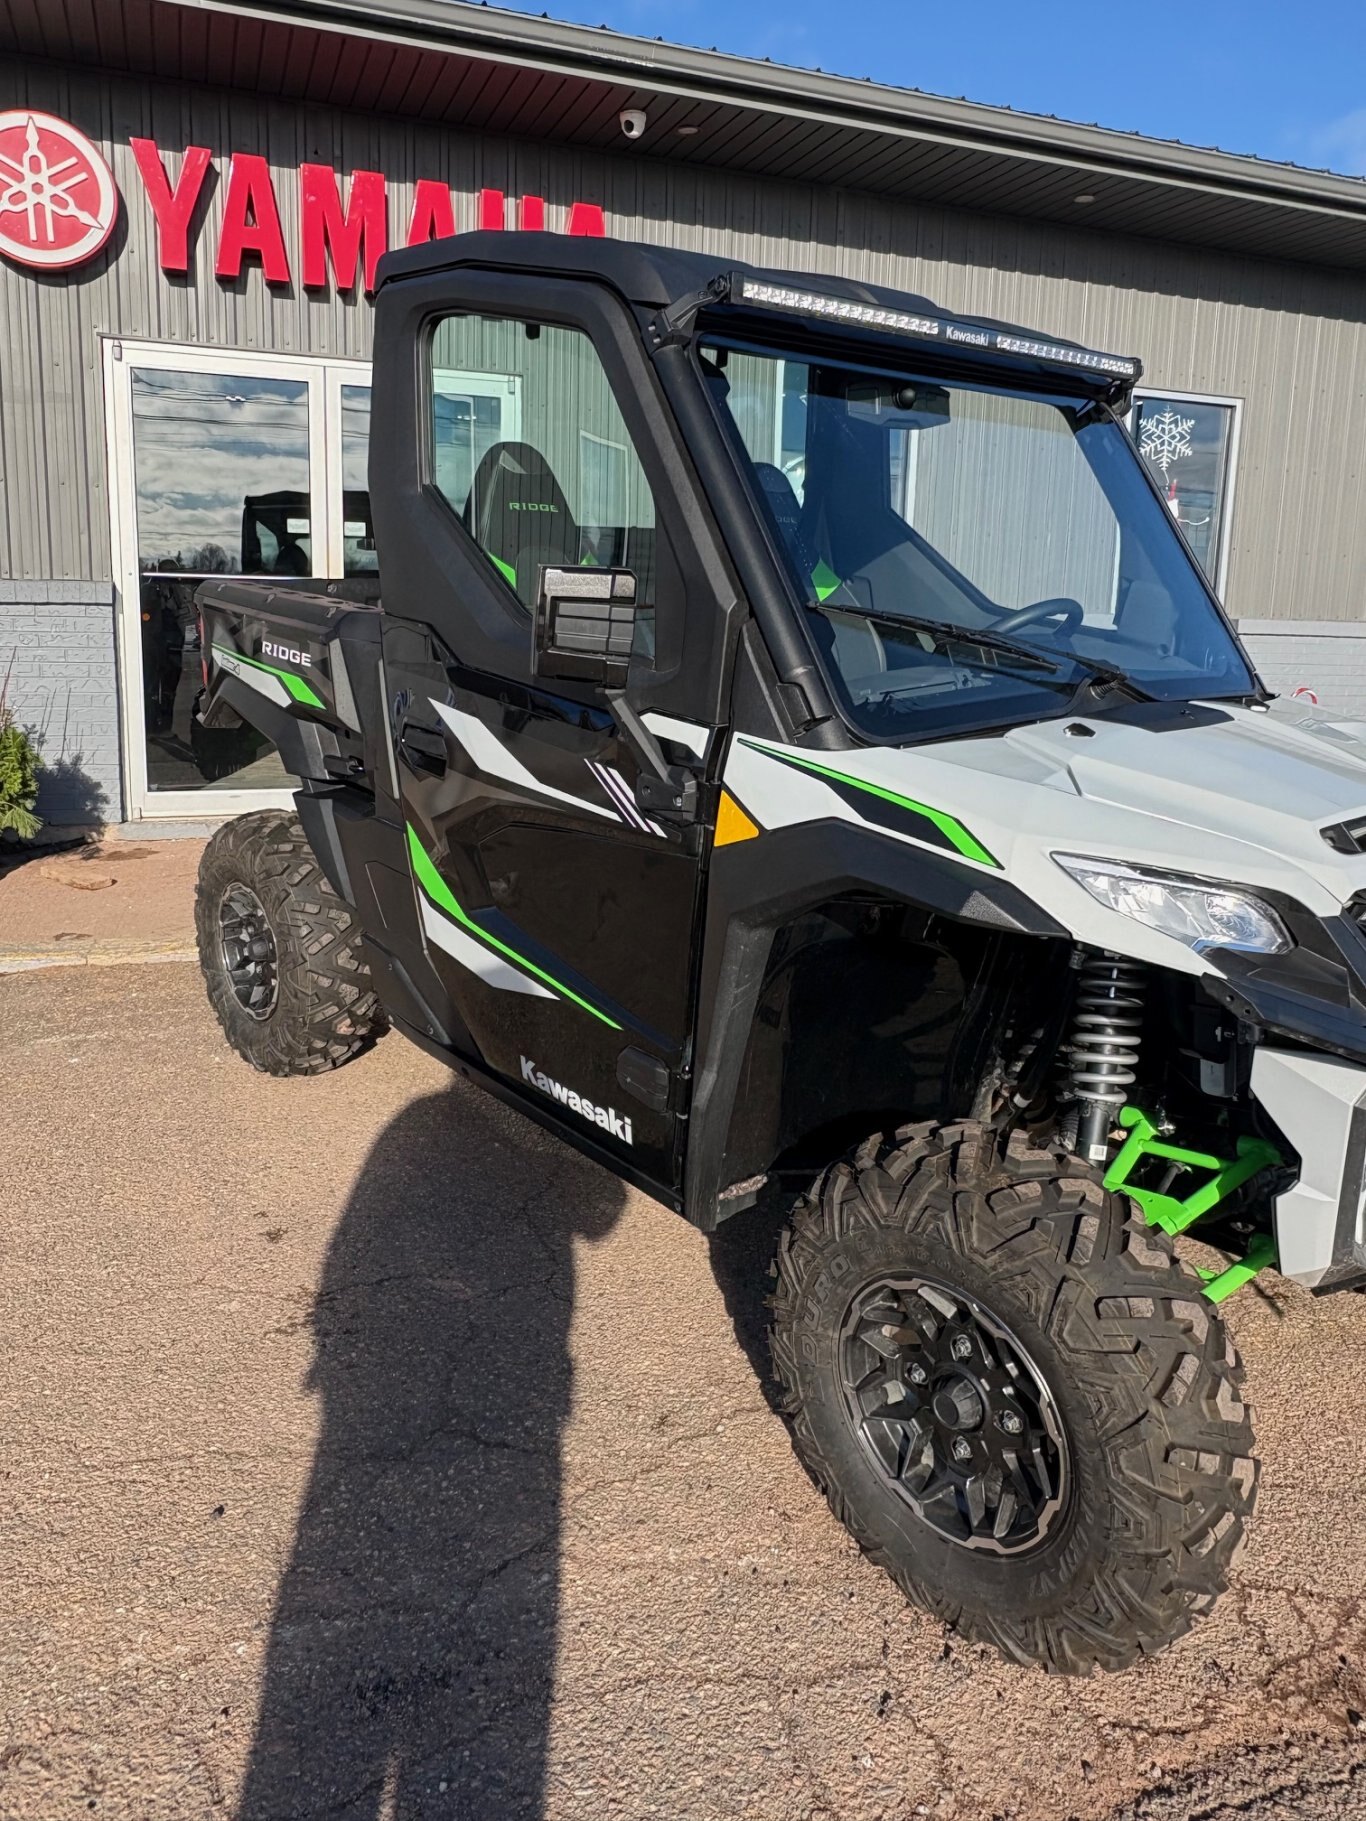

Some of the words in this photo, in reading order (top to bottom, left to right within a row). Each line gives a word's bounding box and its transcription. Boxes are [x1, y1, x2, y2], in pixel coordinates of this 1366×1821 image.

[946, 325, 989, 346] Kawasaki
[508, 502, 559, 513] RIDGE
[261, 641, 312, 667] RIDGE
[520, 1055, 633, 1146] Kawasaki
